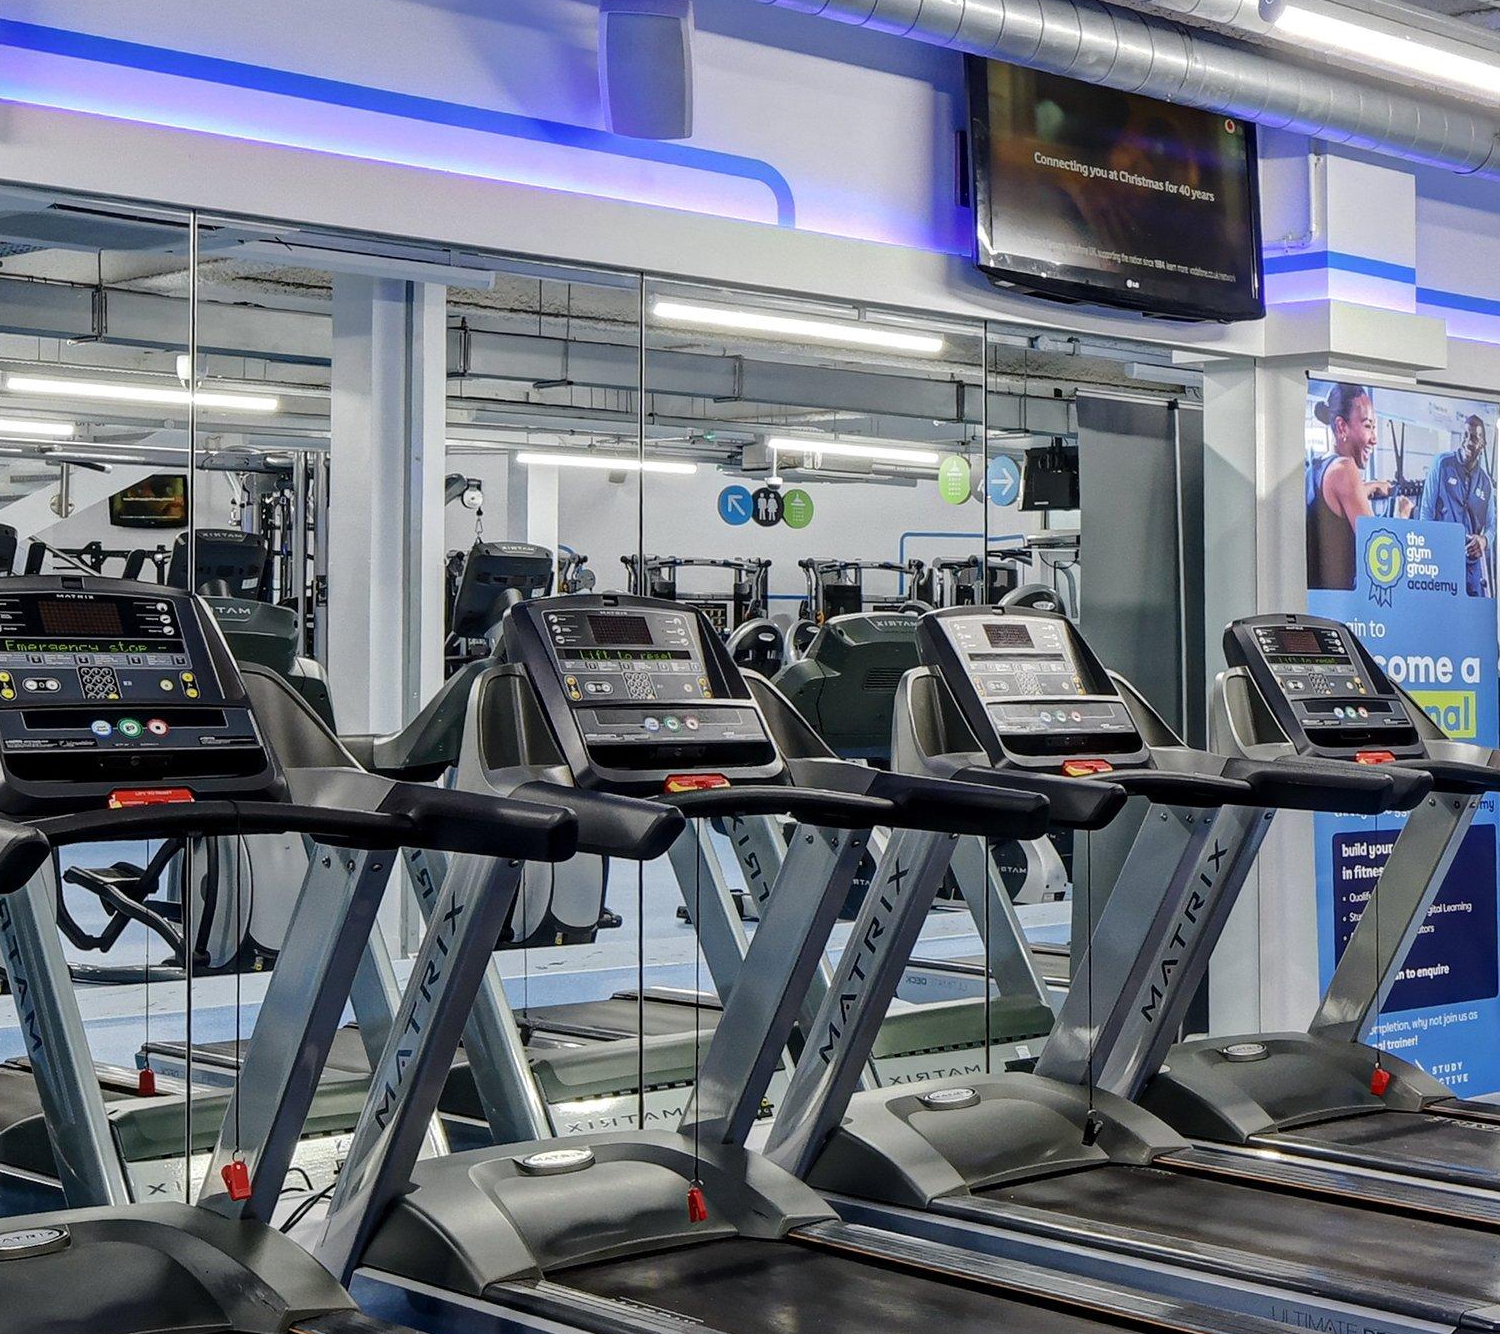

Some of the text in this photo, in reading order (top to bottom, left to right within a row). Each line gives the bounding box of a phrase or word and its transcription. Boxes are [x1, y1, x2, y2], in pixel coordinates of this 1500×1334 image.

[1034, 151, 1215, 202] Connecting you at Christmas for 40 years
[1407, 531, 1425, 546] the
[1406, 547, 1432, 563] gym
[1406, 562, 1439, 580] group
[1407, 578, 1458, 596] academy
[1369, 620, 1385, 638] to
[5, 639, 99, 654] Emergency
[1461, 656, 1480, 684] a
[1342, 842, 1393, 859] build your
[1342, 866, 1352, 880] in
[1443, 901, 1472, 914] Learning
[1141, 838, 1228, 1023] MATRIX
[820, 856, 910, 1064] MATRIX
[1406, 967, 1417, 980] to
[1417, 963, 1450, 980] enquire
[375, 890, 467, 1134] MATRIX
[1412, 1017, 1428, 1031] why
[1429, 1015, 1443, 1027] not
[1443, 1013, 1458, 1028] join
[1458, 1011, 1468, 1023] us
[1468, 1010, 1479, 1021] as
[1386, 1034, 1418, 1051] trainer!
[1432, 1061, 1464, 1076] STUDY
